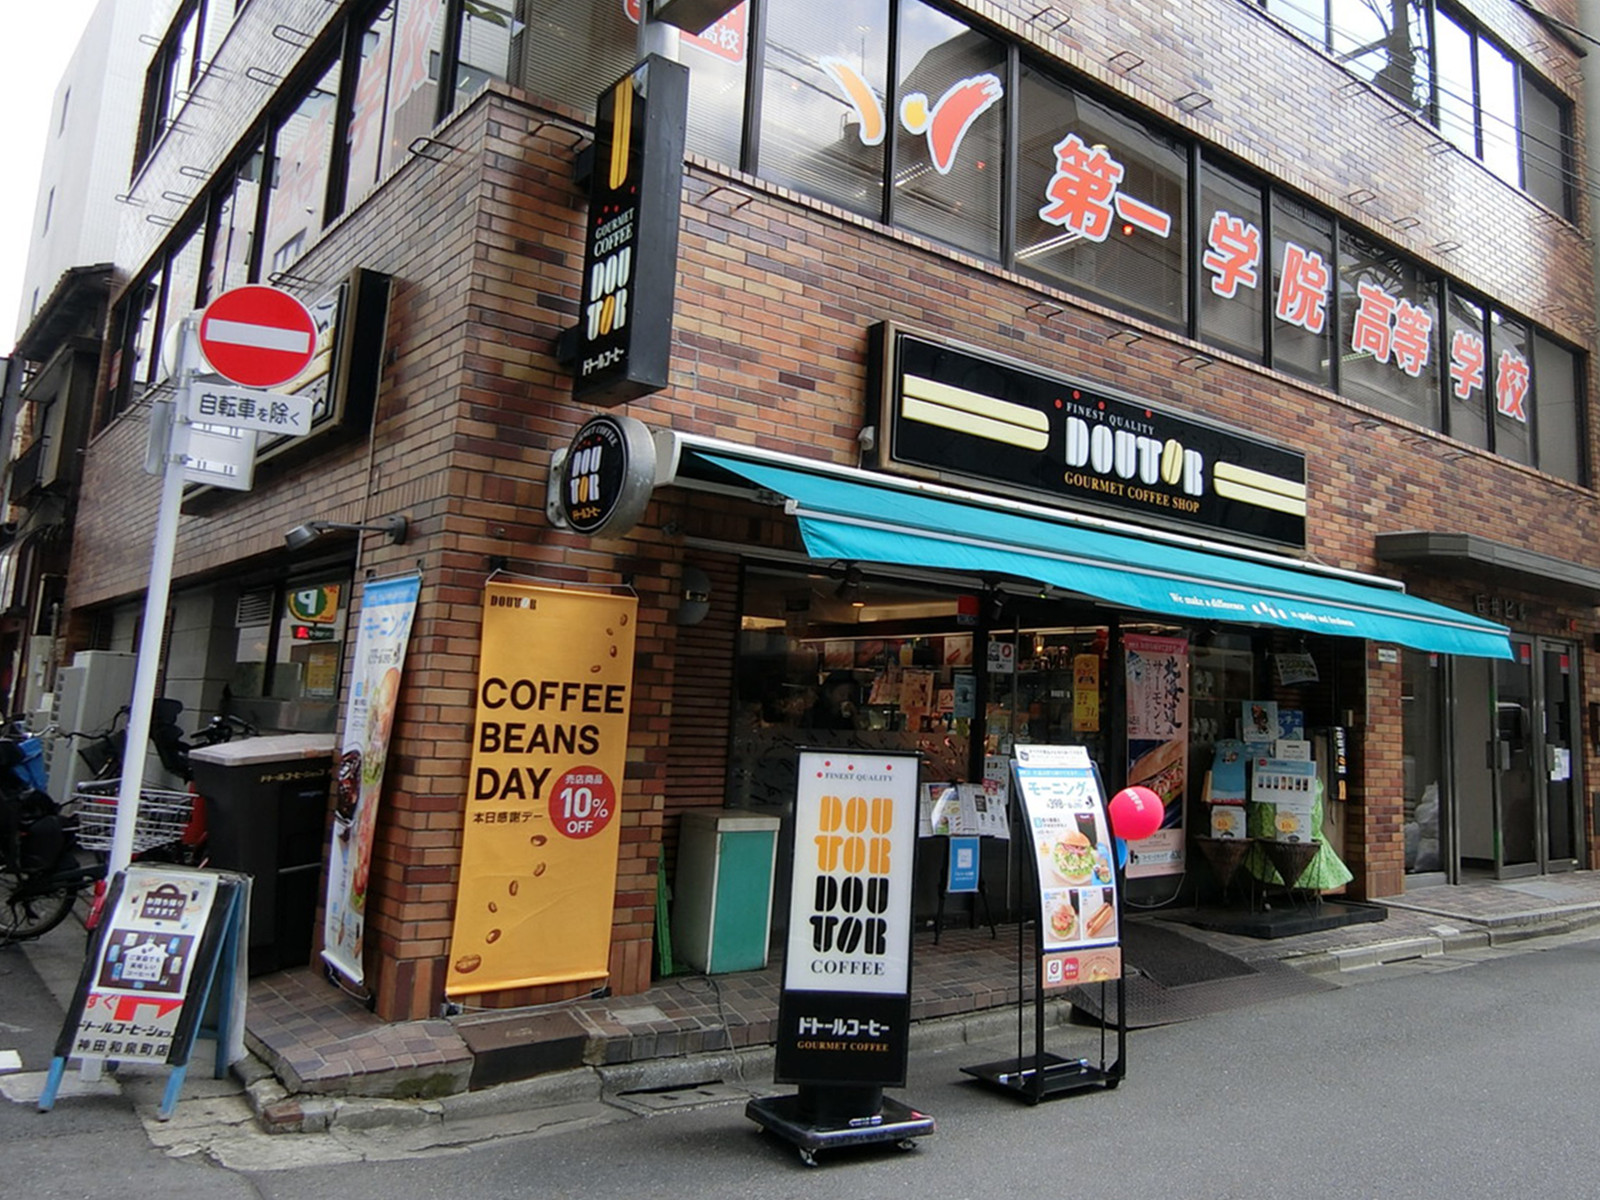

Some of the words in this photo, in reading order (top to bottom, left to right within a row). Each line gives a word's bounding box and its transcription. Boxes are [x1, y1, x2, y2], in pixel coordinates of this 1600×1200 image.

[595, 207, 635, 240] GOURMET
[594, 222, 634, 257] COFFEE
[199, 392, 300, 426] 自転車を除く
[1066, 402, 1105, 421] FINEST
[1108, 414, 1155, 435] QUALITY
[1065, 416, 1203, 496] DOUTOR
[1064, 471, 1125, 497] GOURMET
[1127, 485, 1170, 507] COFFEE
[1172, 498, 1201, 513] SHOP
[490, 595, 537, 610] DOUTOR
[481, 677, 626, 714] COFFEE
[479, 722, 600, 755] BEANS
[475, 767, 552, 801] DAY
[564, 774, 603, 785] 売店商品
[825, 772, 853, 780] FINEST
[856, 773, 893, 782] QUALITY
[1028, 781, 1086, 796] モーニング
[560, 787, 608, 818] 10%
[473, 811, 544, 824] 本日感謝デー
[567, 821, 594, 834] OFF
[811, 960, 885, 976] COFFEE
[87, 994, 118, 1009] すぐ
[799, 1017, 889, 1036] ドトールコーヒー
[77, 1038, 169, 1056] 神田和泉町店
[797, 1041, 847, 1050] GOURMET
[850, 1042, 889, 1051] COFFEE
